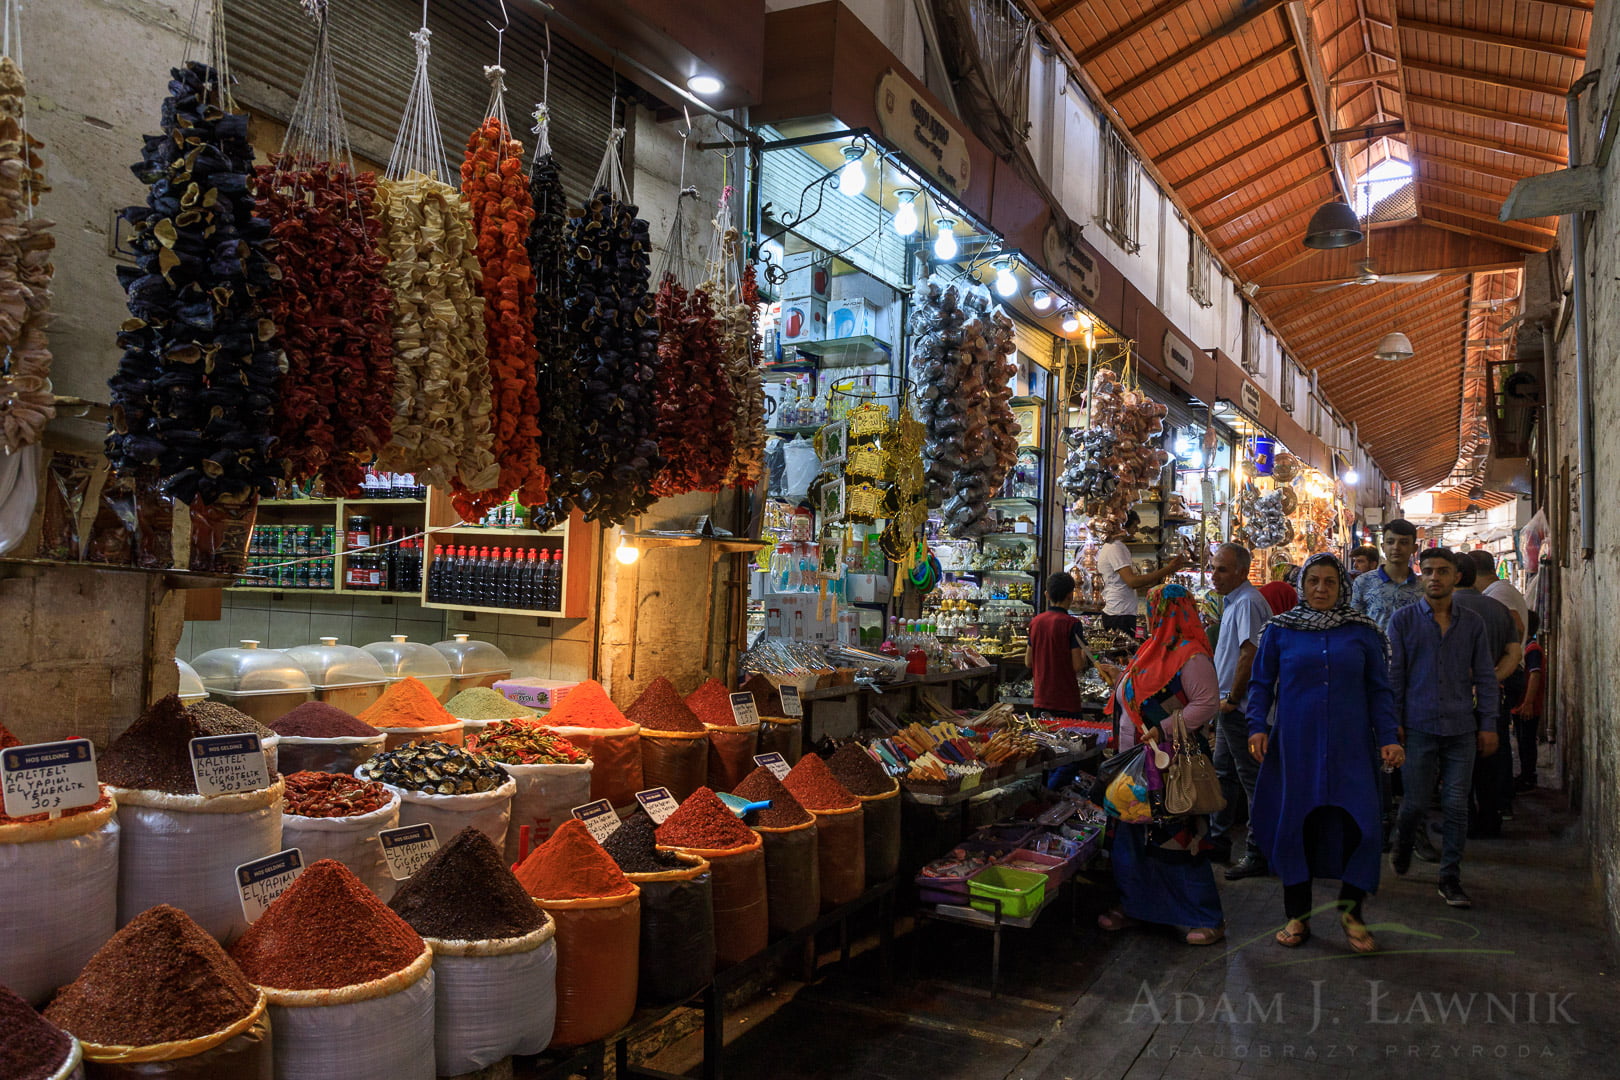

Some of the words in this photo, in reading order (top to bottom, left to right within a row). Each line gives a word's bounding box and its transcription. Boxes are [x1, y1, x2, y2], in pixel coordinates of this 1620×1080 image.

[198, 769, 211, 777] EL
[7, 784, 24, 794] EL
[28, 777, 70, 790] YAPIMI
